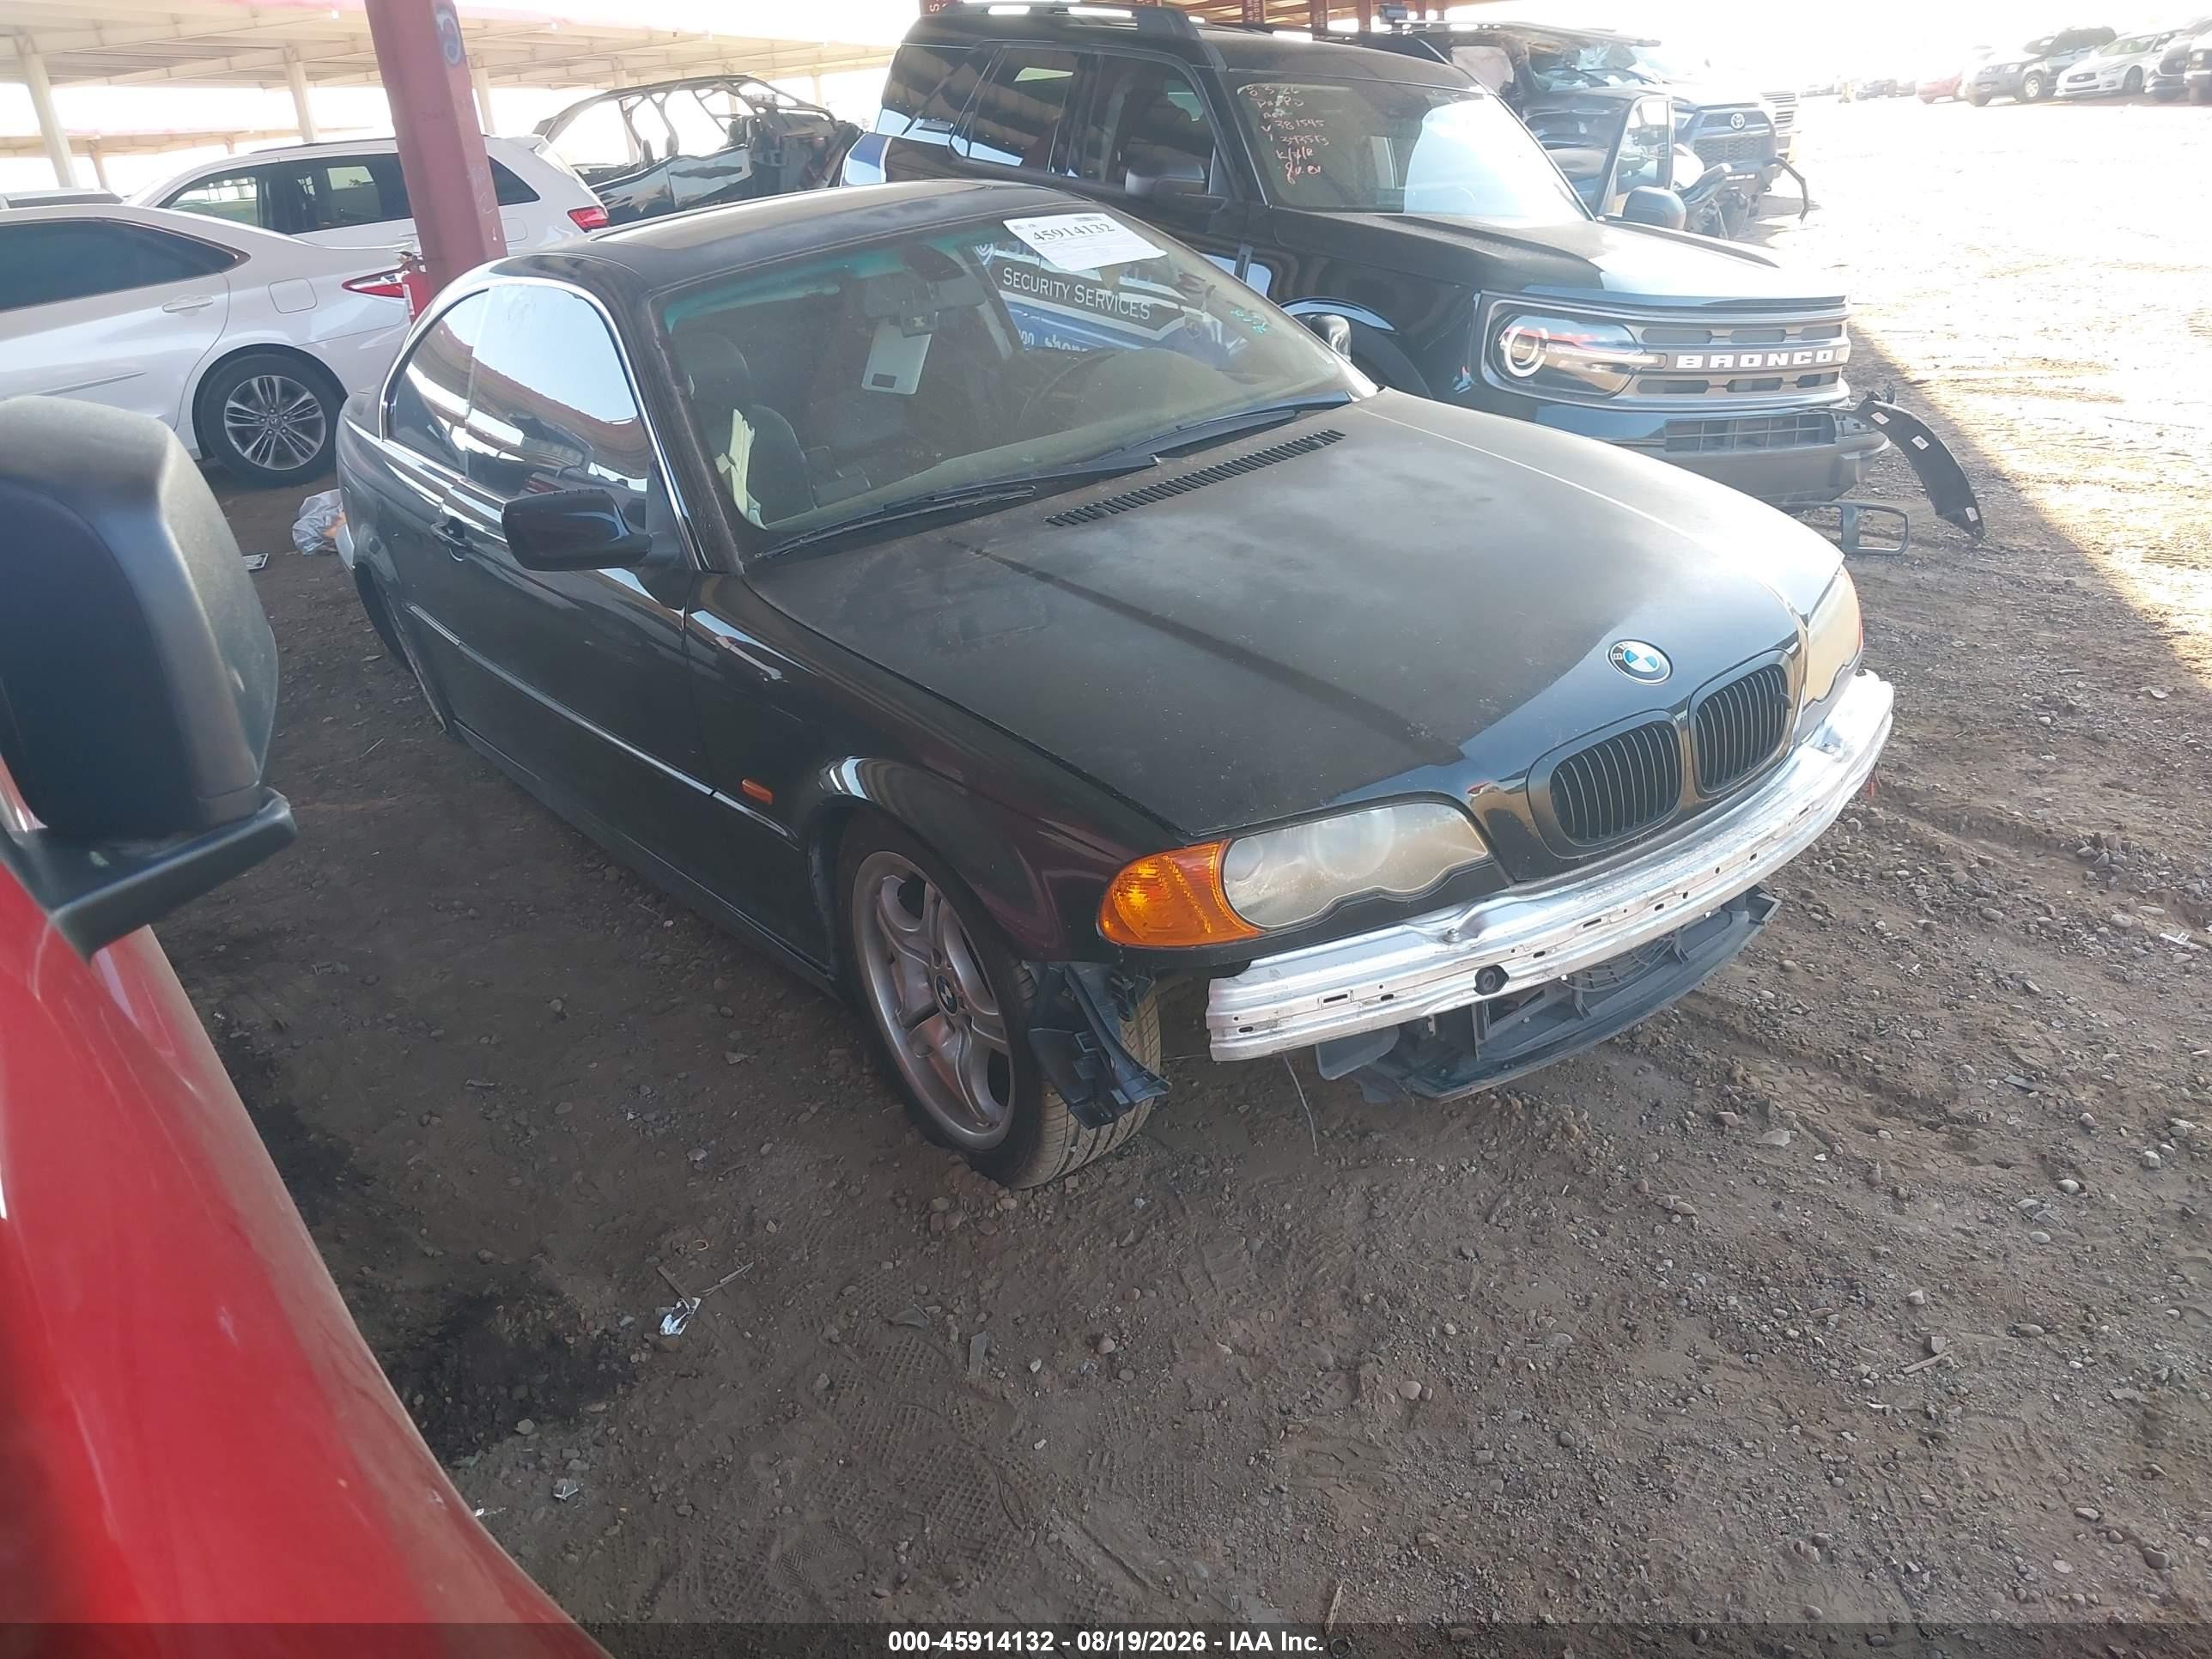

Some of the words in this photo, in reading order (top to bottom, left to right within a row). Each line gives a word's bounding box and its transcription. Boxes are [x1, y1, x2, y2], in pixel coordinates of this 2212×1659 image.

[1033, 223, 1115, 240] 45914132
[1003, 267, 1071, 301] SECURITY
[1073, 284, 1152, 320] SERVICES
[1675, 349, 1834, 369] BRONCO
